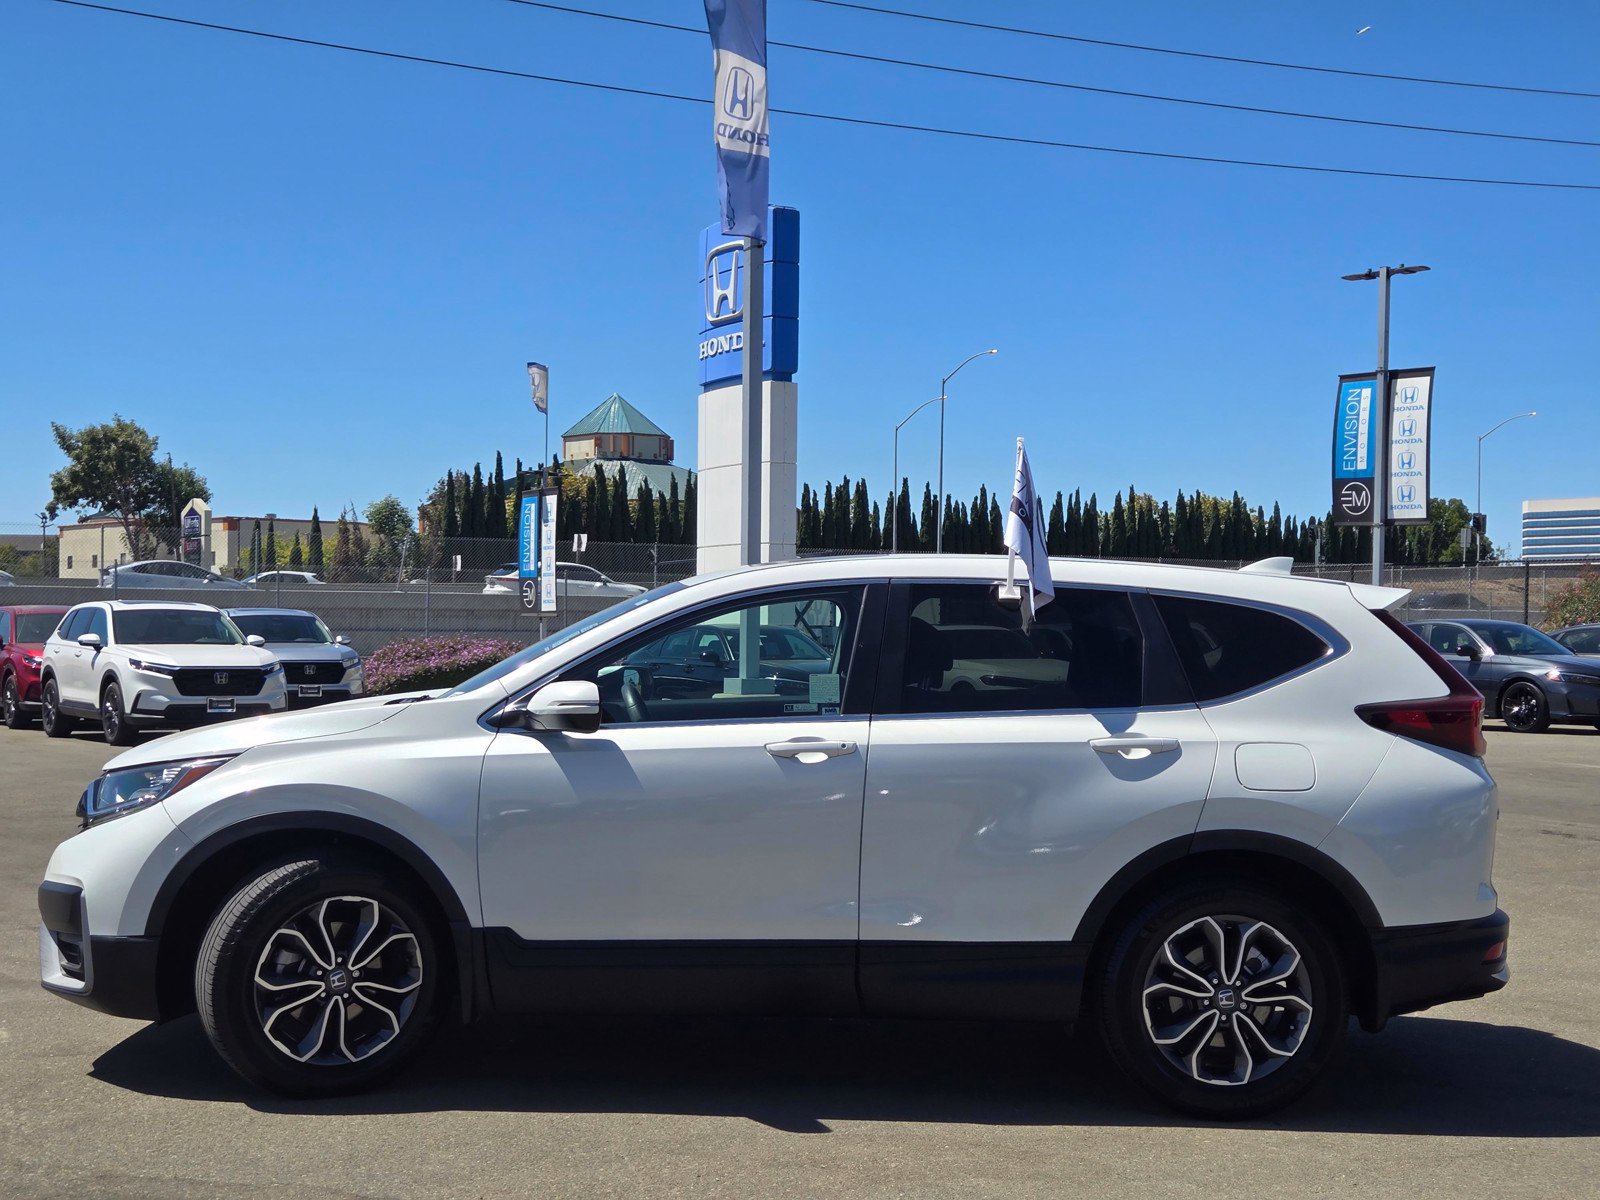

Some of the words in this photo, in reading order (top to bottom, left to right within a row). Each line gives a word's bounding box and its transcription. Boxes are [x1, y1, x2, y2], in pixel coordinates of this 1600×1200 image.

[699, 332, 765, 360] HOND
[1343, 388, 1361, 471] ENVISION
[1359, 395, 1369, 463] MOTORS
[523, 503, 531, 571] ENVISION
[1390, 503, 1423, 511] HONDA
